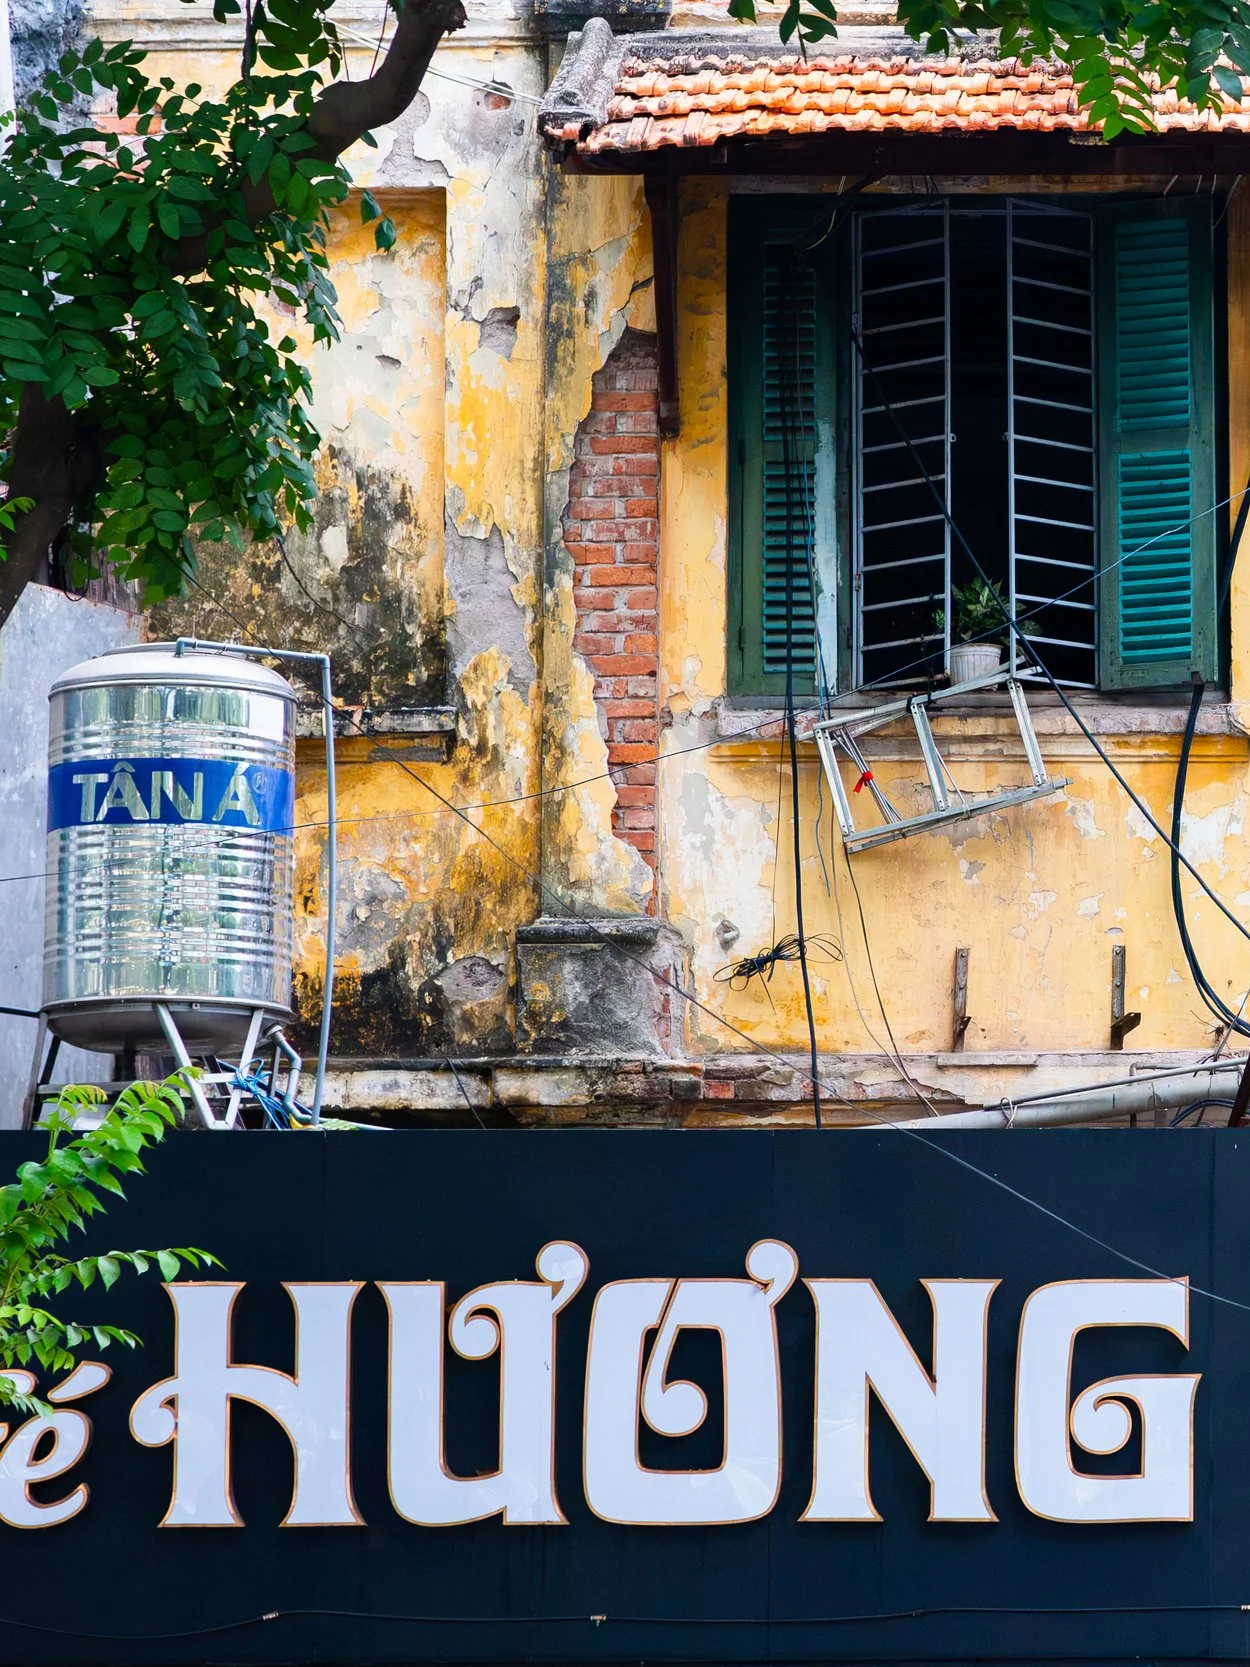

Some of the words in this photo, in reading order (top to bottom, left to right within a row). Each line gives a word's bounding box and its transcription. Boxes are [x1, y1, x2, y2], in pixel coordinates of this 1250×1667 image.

[72, 761, 204, 823] TÂN
[212, 763, 261, 825] Á
[0, 1360, 113, 1530] é
[129, 1238, 1202, 1528] HƯƠNG
